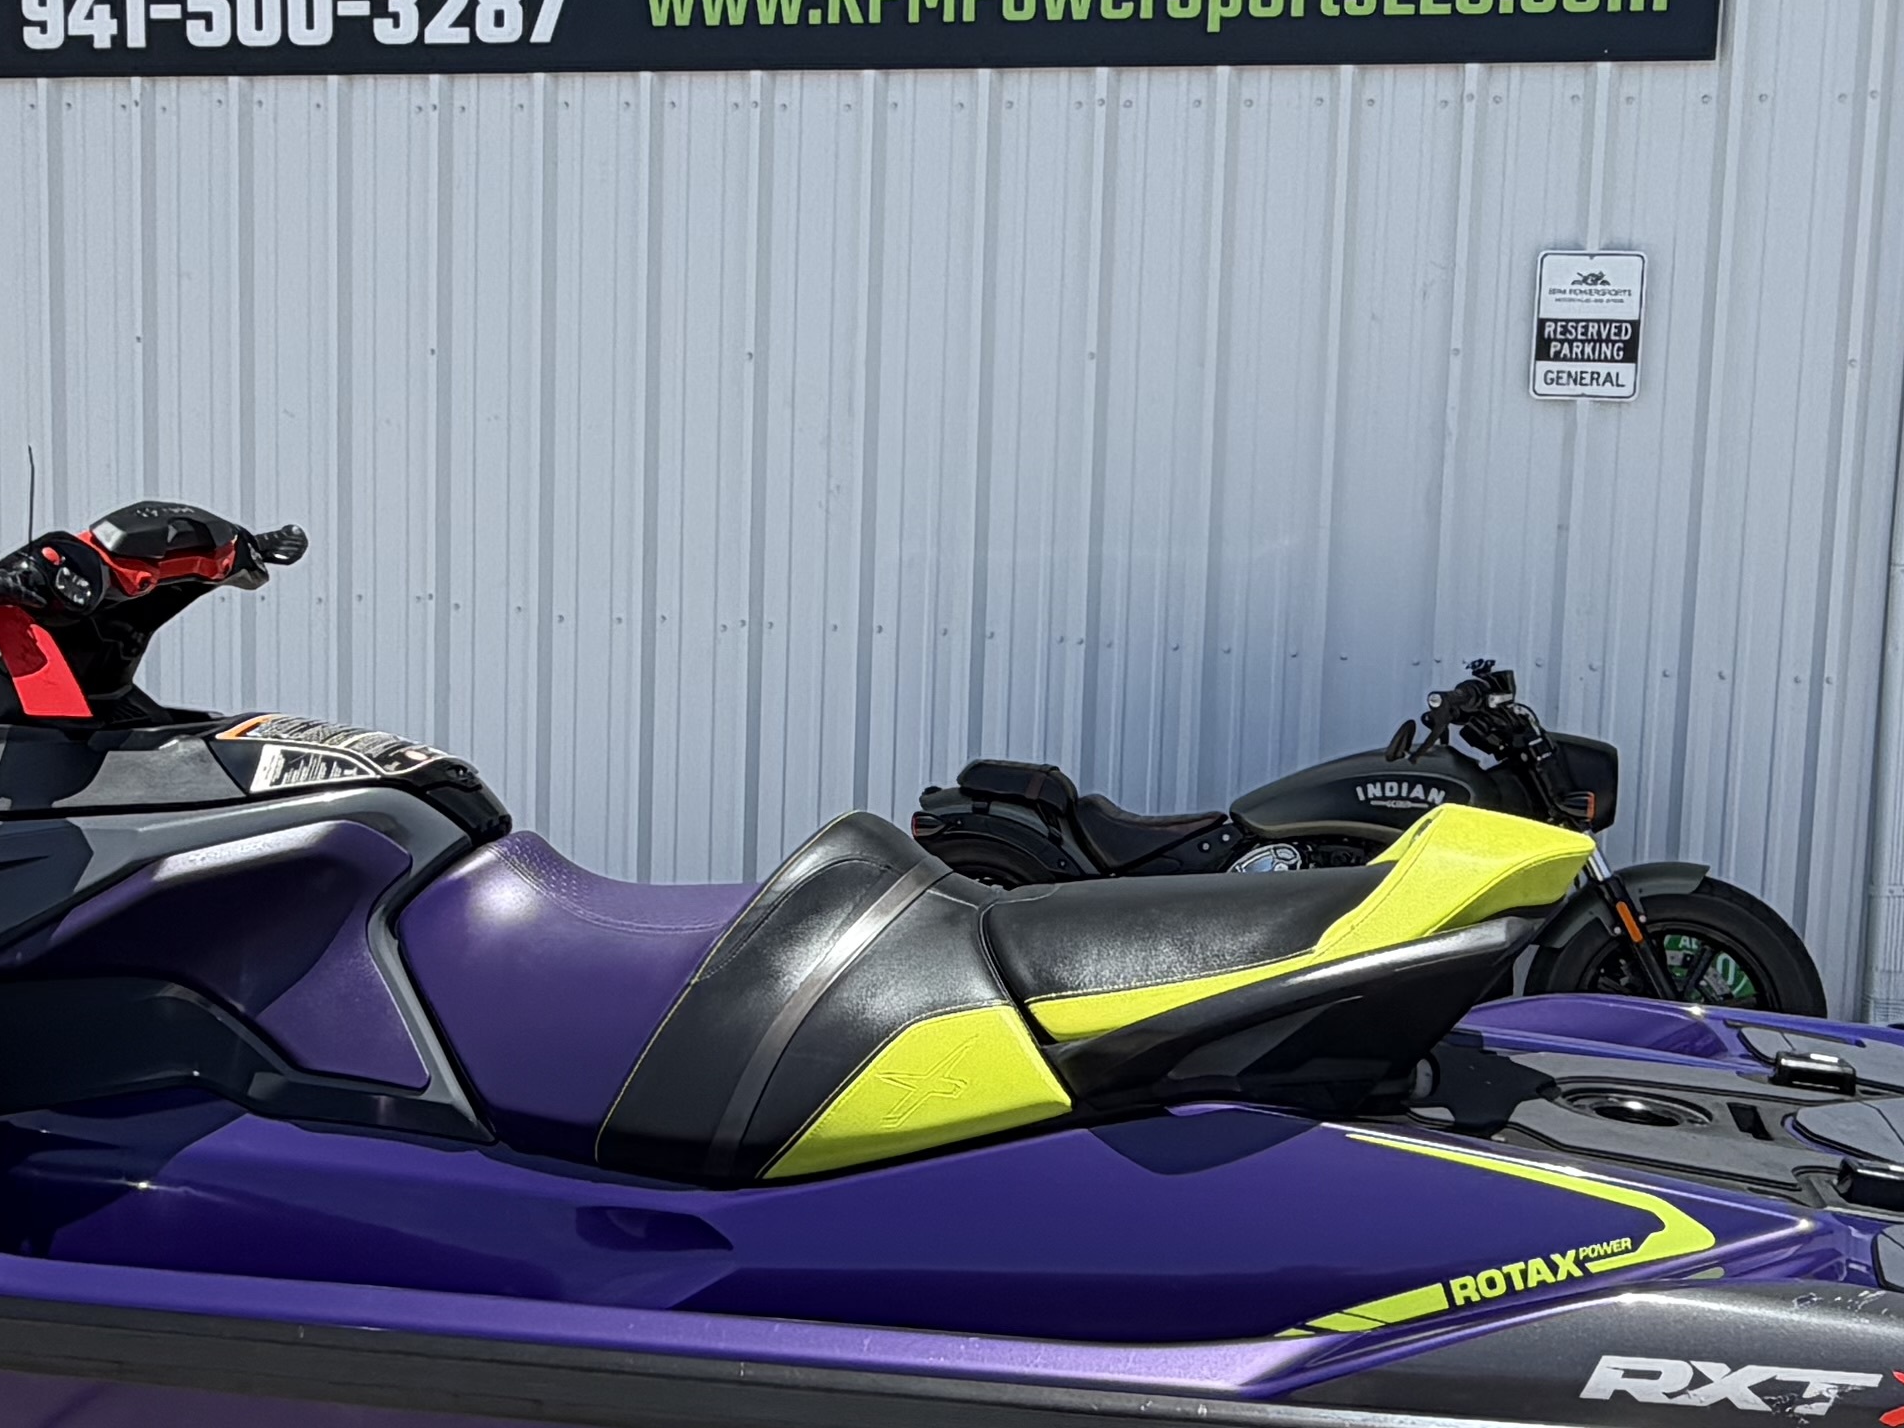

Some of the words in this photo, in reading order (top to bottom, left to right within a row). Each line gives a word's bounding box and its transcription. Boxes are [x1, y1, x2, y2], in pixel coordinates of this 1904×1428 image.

[1544, 321, 1632, 341] RESERVED
[1549, 341, 1625, 361] PARKING
[1543, 369, 1626, 388] GENERAL
[1356, 781, 1446, 805] INDIAN
[1449, 1249, 1584, 1306] ROTAX
[1578, 1237, 1632, 1260] POWER
[1579, 1354, 1884, 1416] RXT
